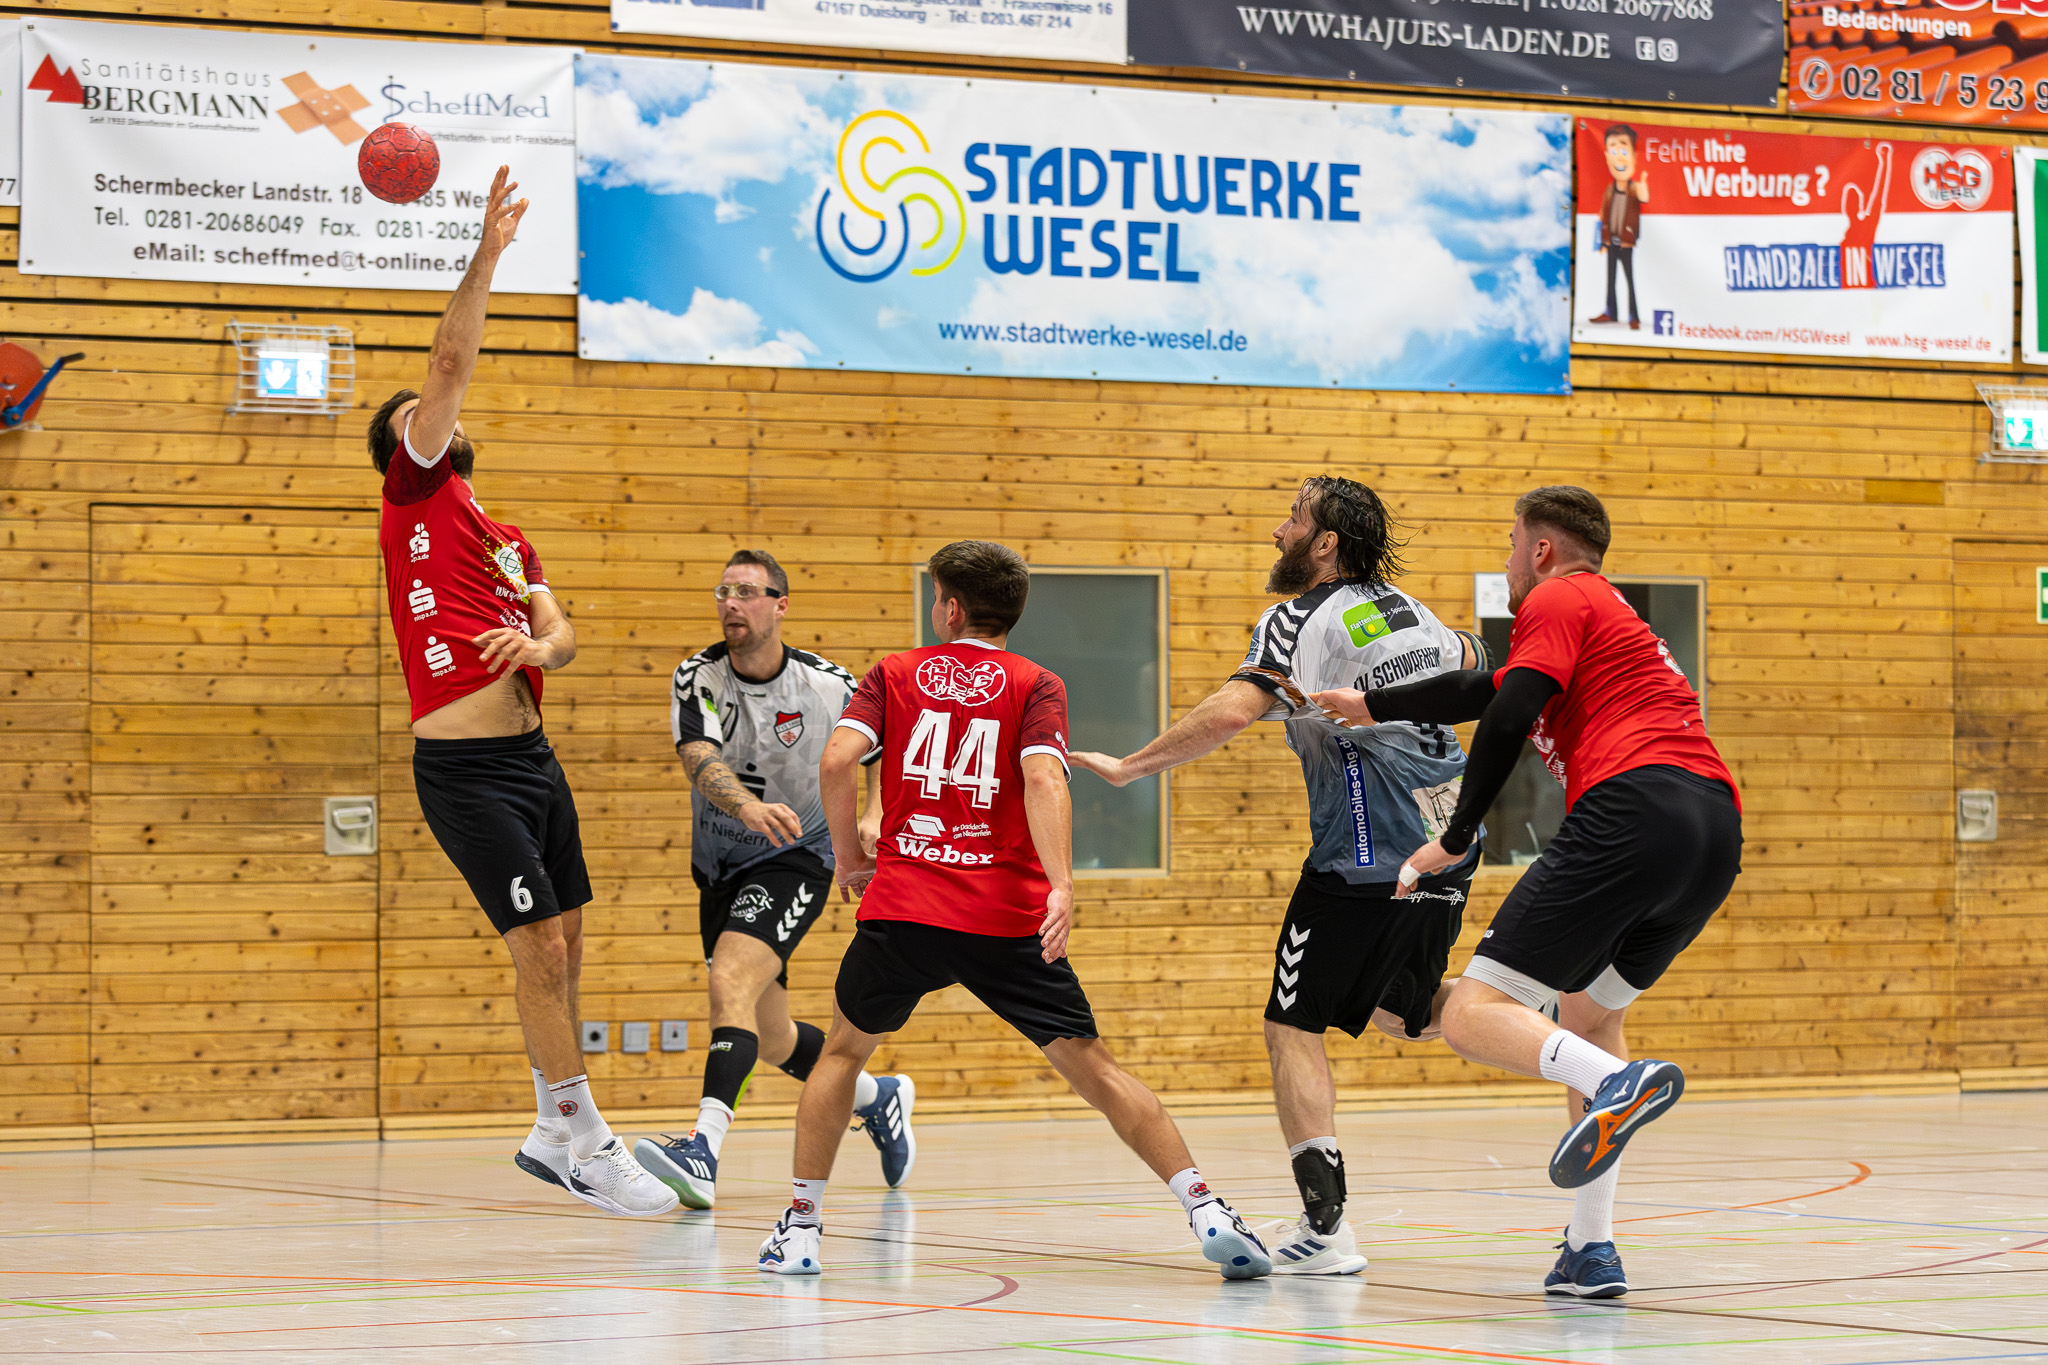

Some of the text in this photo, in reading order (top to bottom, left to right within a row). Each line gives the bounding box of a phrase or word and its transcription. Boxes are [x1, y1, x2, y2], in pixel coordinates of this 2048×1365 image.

[859, 4, 926, 23] Duisburg
[1822, 6, 1972, 39] Bedachungen
[1236, 6, 1611, 60] WWW.HAJUES-LADEN.DE
[81, 58, 271, 87] Sanitätshaus
[1842, 66, 1881, 101] 02
[1890, 69, 1925, 104] 81
[1958, 74, 1978, 107] 5
[1987, 76, 2025, 111] 23
[80, 85, 269, 119] BERGMANN
[381, 83, 550, 124] ScheffMed
[1645, 137, 1747, 163] Fehlt Ihre
[94, 173, 245, 200] Schermbecker
[252, 181, 333, 203] Landstr.
[341, 186, 363, 205] 18
[963, 142, 1361, 223] STADTWERKE
[1682, 165, 1811, 206] Werbung
[1923, 160, 1982, 190] HSG
[94, 206, 130, 226] Tel.
[145, 209, 305, 233] 0281-20686049
[320, 217, 360, 238] Fax.
[133, 242, 468, 272] eMail: scheffmed@t-online.d
[982, 213, 1199, 283] WESEL
[1725, 245, 1945, 289] HANDBALL IN WESEL
[938, 319, 1248, 352] www.stadtwerke-wesel.de
[1678, 321, 1992, 353] facebook.com/HSGWesel www.hsg-wesel.de
[431, 664, 456, 678] nispa.de
[902, 708, 1001, 809] 44
[895, 836, 994, 865] Weber
[510, 875, 534, 913] 6
